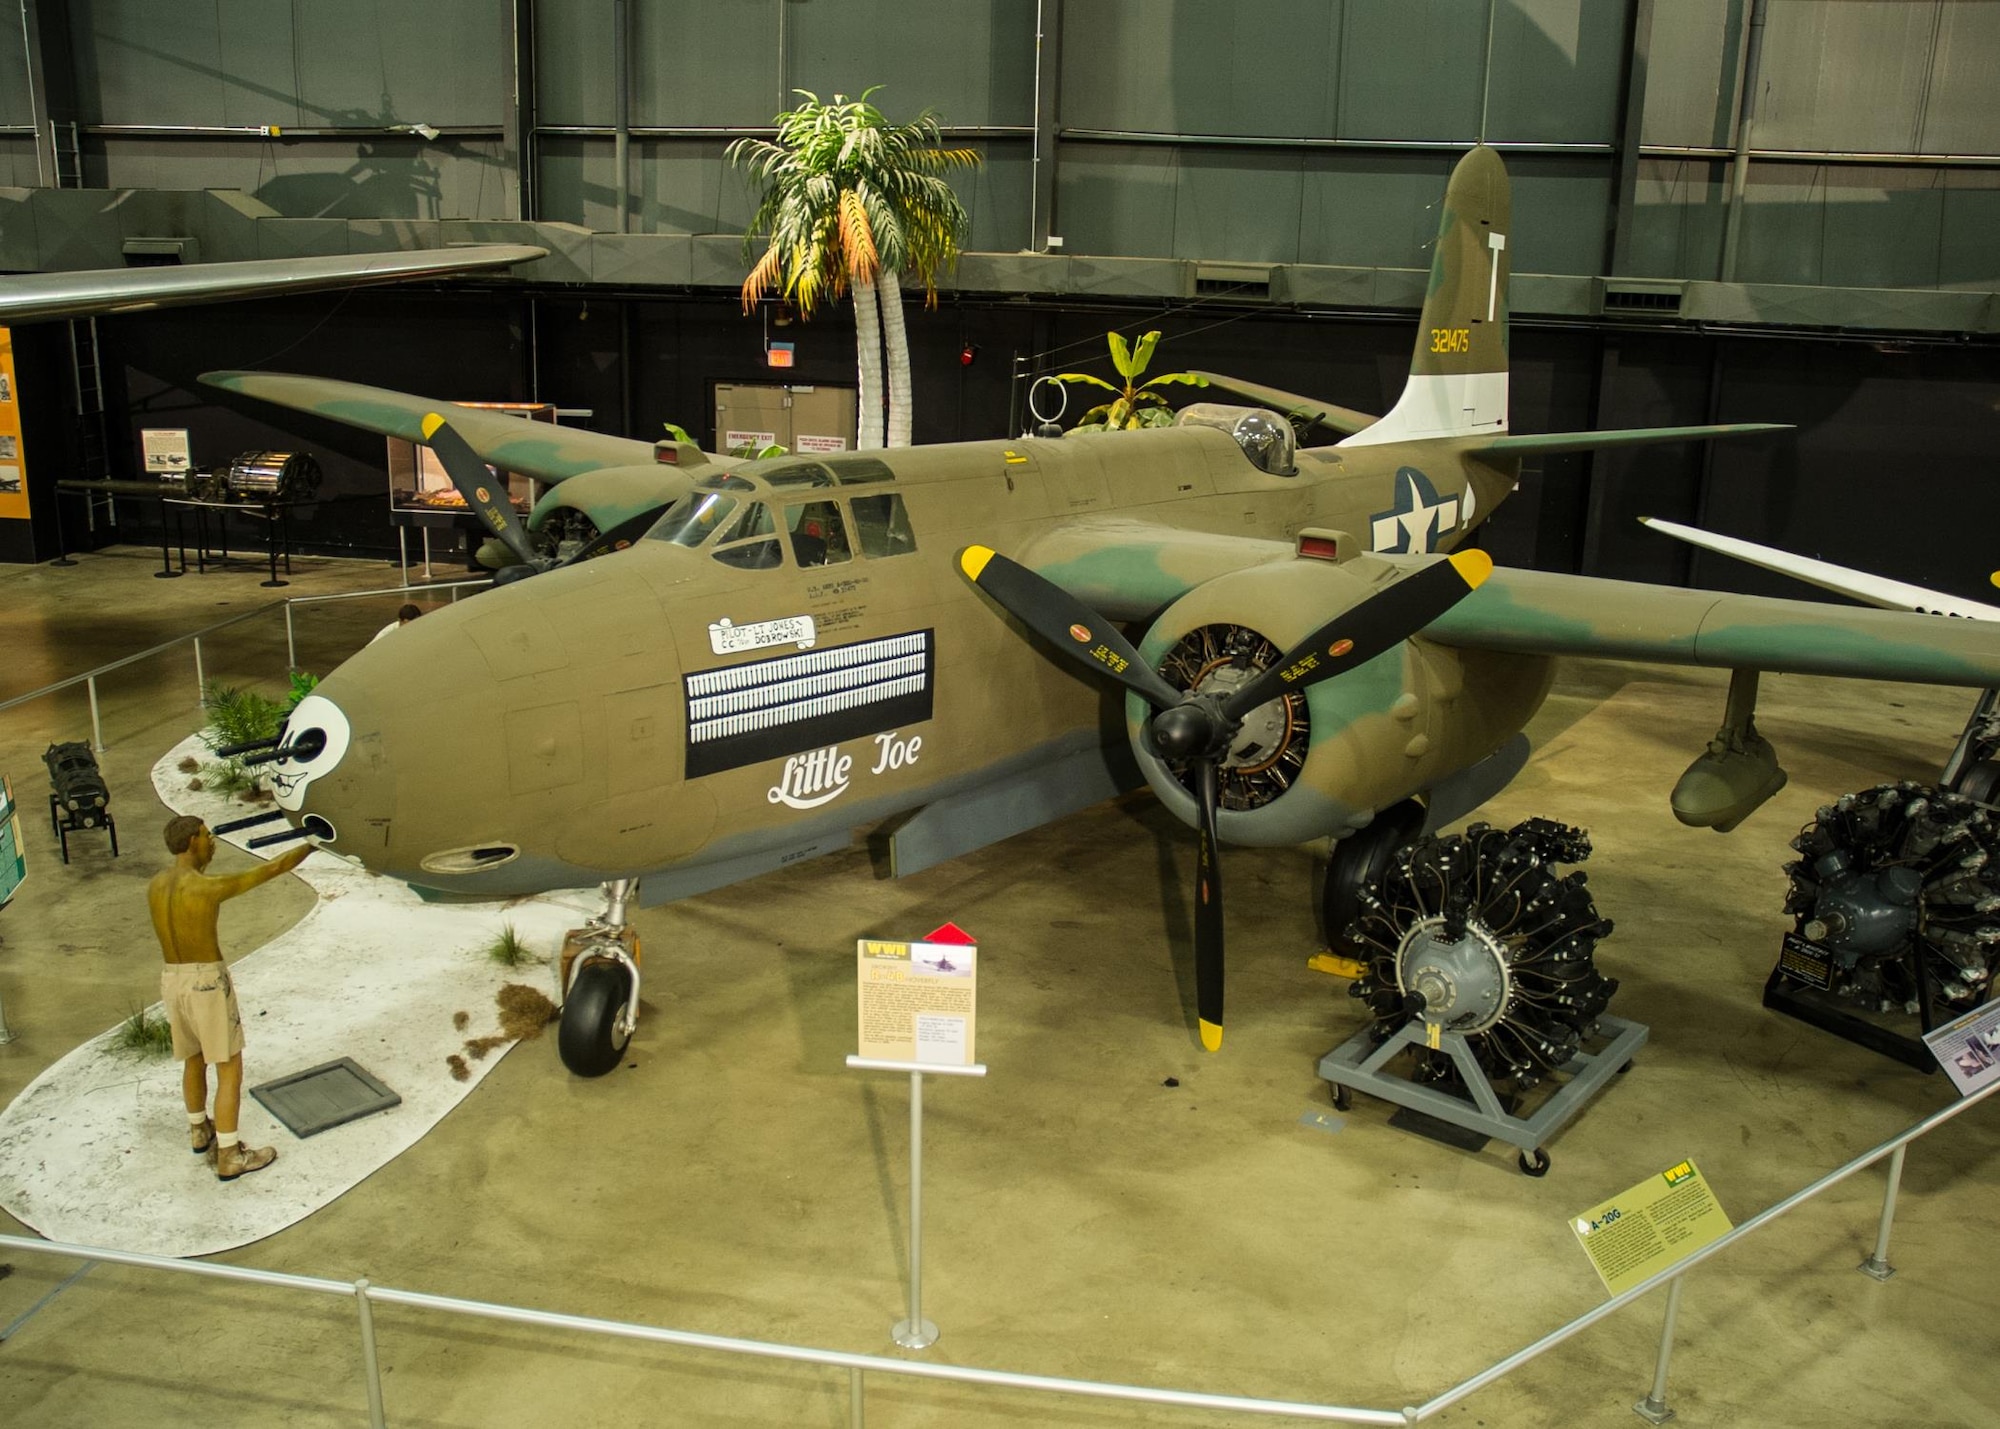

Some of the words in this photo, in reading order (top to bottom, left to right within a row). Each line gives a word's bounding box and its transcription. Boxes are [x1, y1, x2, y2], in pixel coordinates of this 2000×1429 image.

[1430, 328, 1470, 353] 321475
[755, 628, 803, 644] DOBROWSKI
[767, 746, 852, 810] Little
[871, 731, 922, 775] Joe
[867, 942, 907, 956] WWII
[1664, 1161, 1691, 1182] WWII
[1591, 1208, 1622, 1231] A-20G
